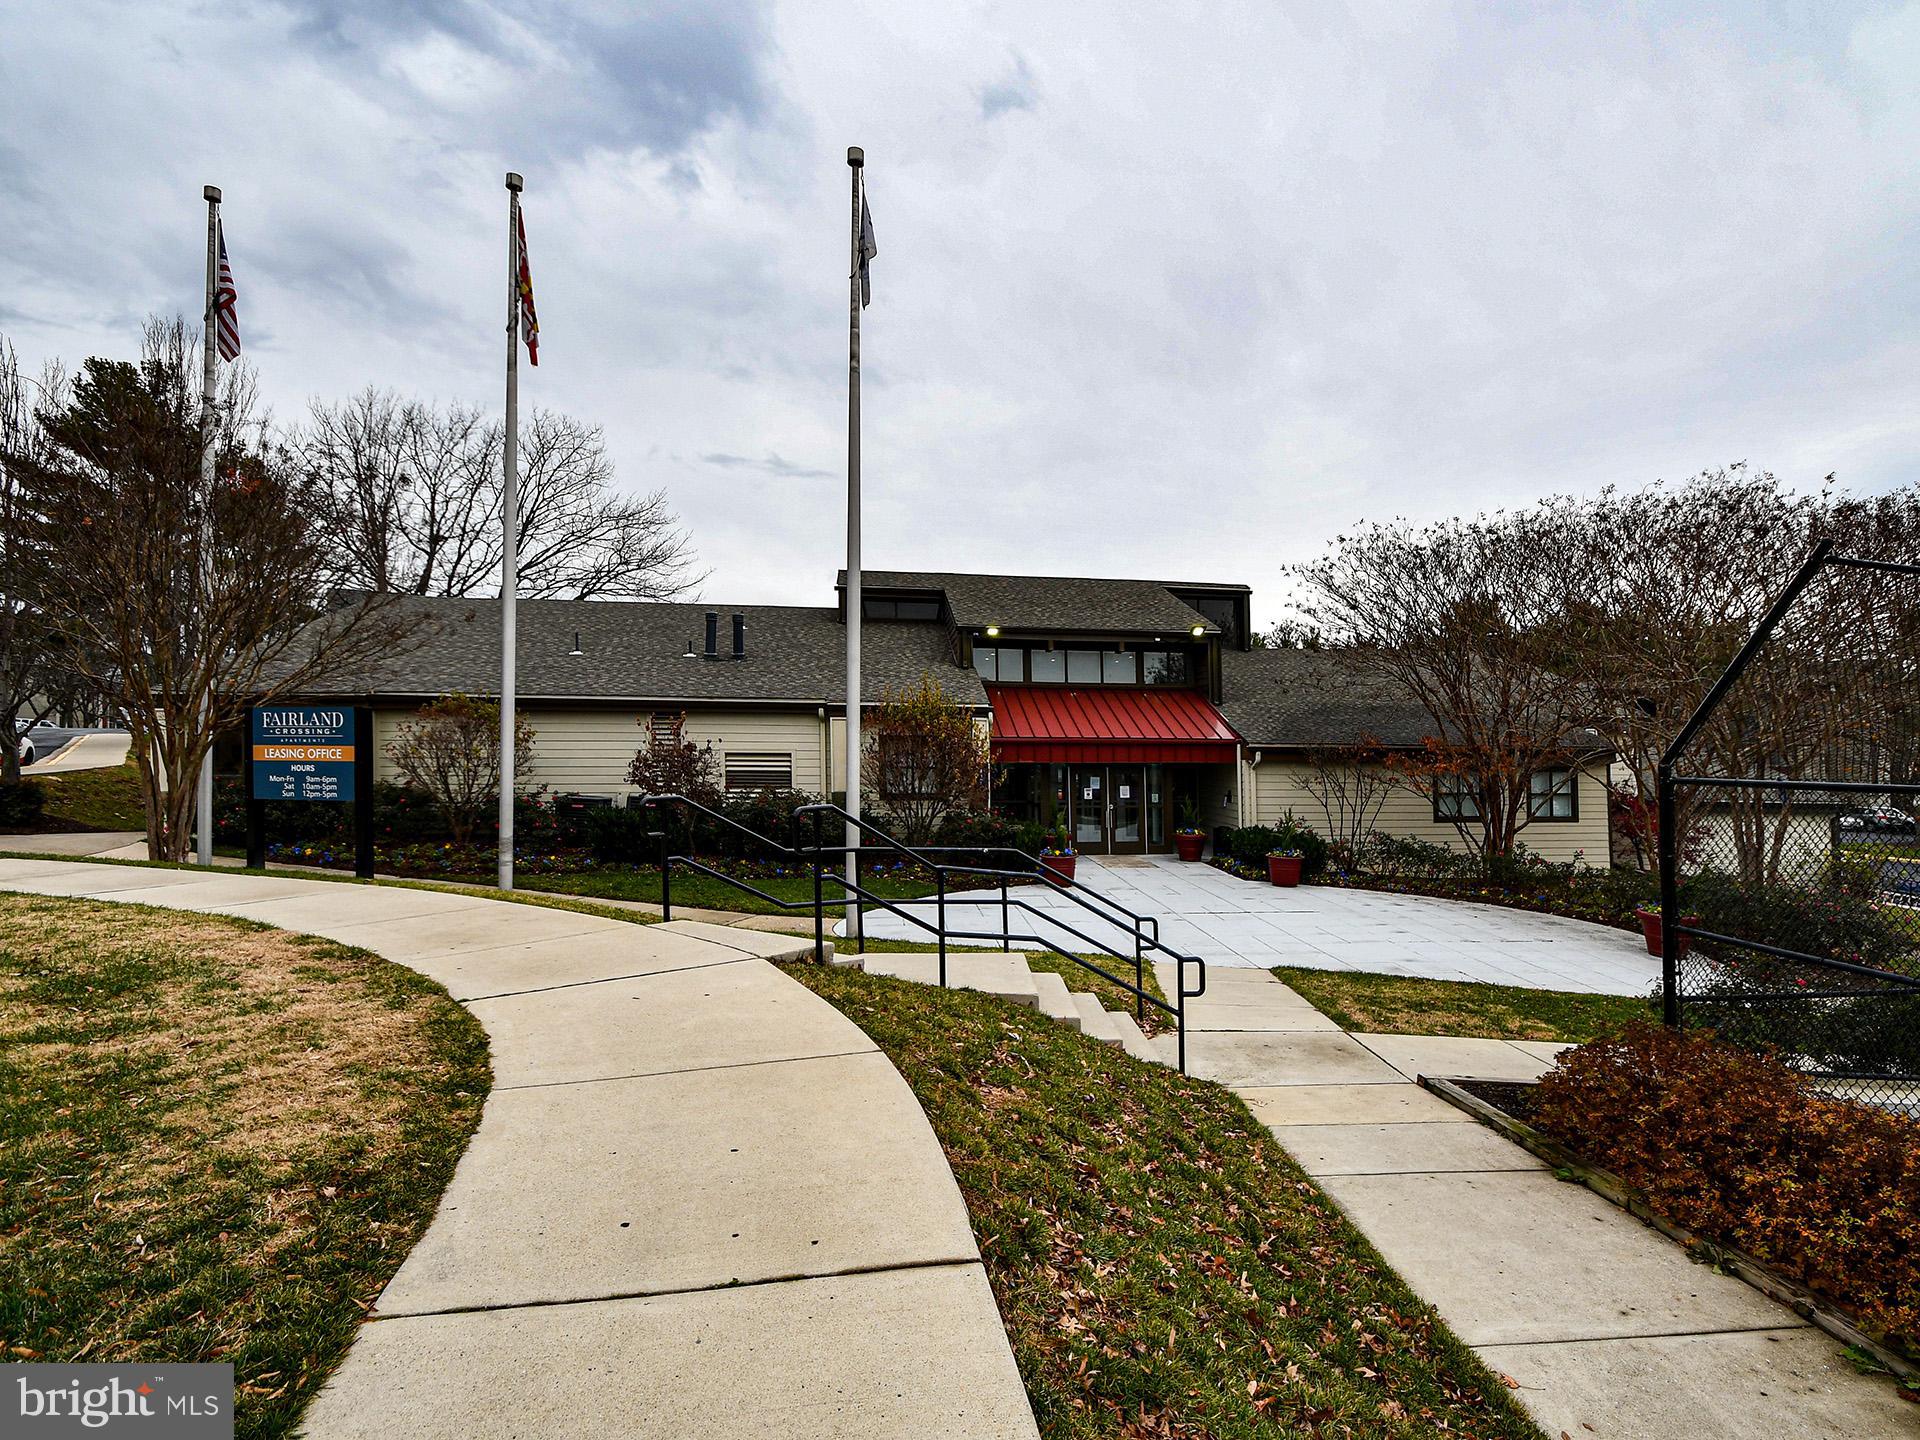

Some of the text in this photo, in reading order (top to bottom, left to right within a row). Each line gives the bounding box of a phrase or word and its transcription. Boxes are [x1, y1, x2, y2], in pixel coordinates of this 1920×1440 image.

[262, 712, 344, 728] FAIRLAND
[264, 748, 342, 759] LEASING OFFICE
[291, 764, 315, 772] HOURS
[305, 775, 337, 783] 9am-6pm
[302, 790, 337, 799] 12pm-5pm
